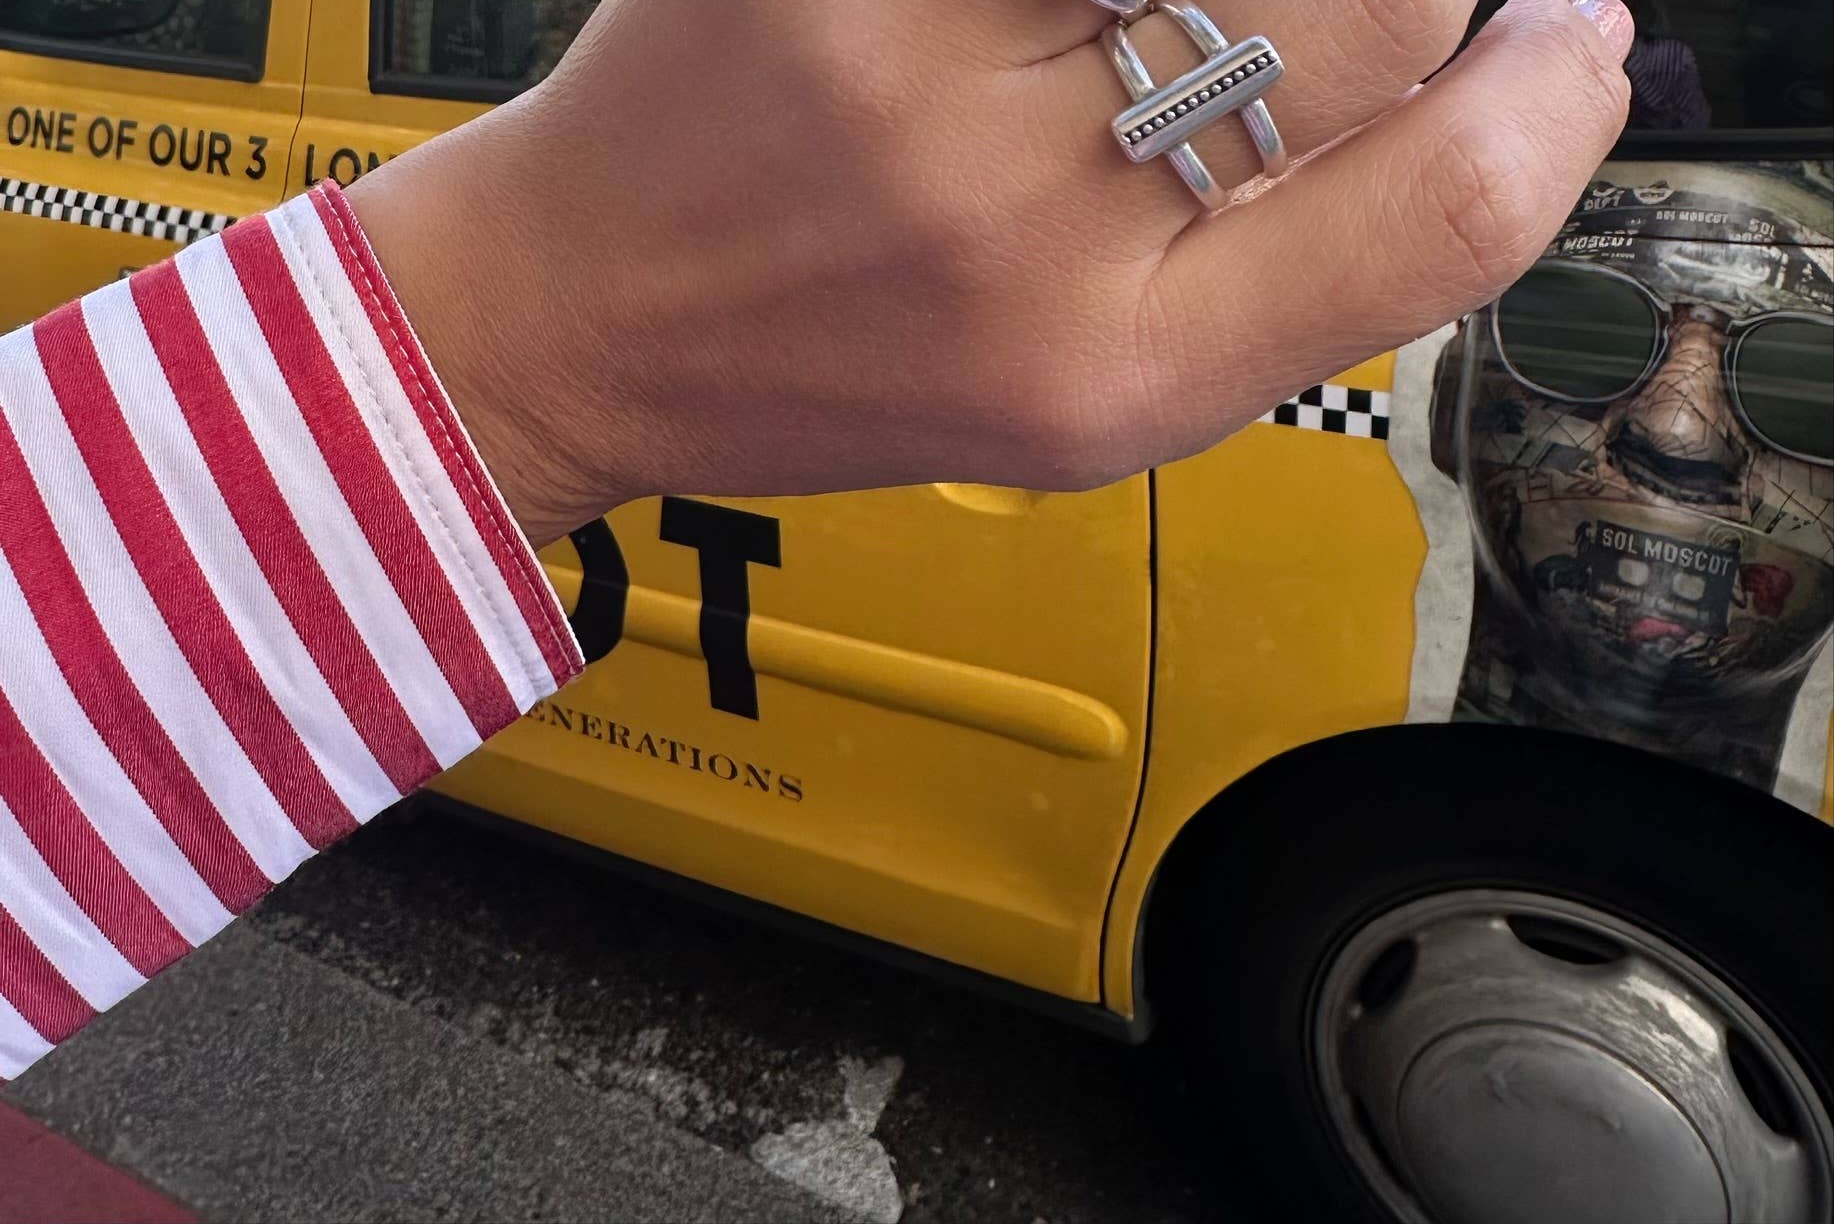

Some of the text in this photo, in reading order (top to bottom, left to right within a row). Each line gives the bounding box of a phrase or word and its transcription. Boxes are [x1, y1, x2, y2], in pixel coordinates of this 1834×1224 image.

[7, 105, 77, 153] ONE
[88, 116, 138, 160] OF
[149, 123, 232, 176] OUR
[245, 135, 269, 180] 3
[1602, 528, 1734, 577] SOL MOSCOT
